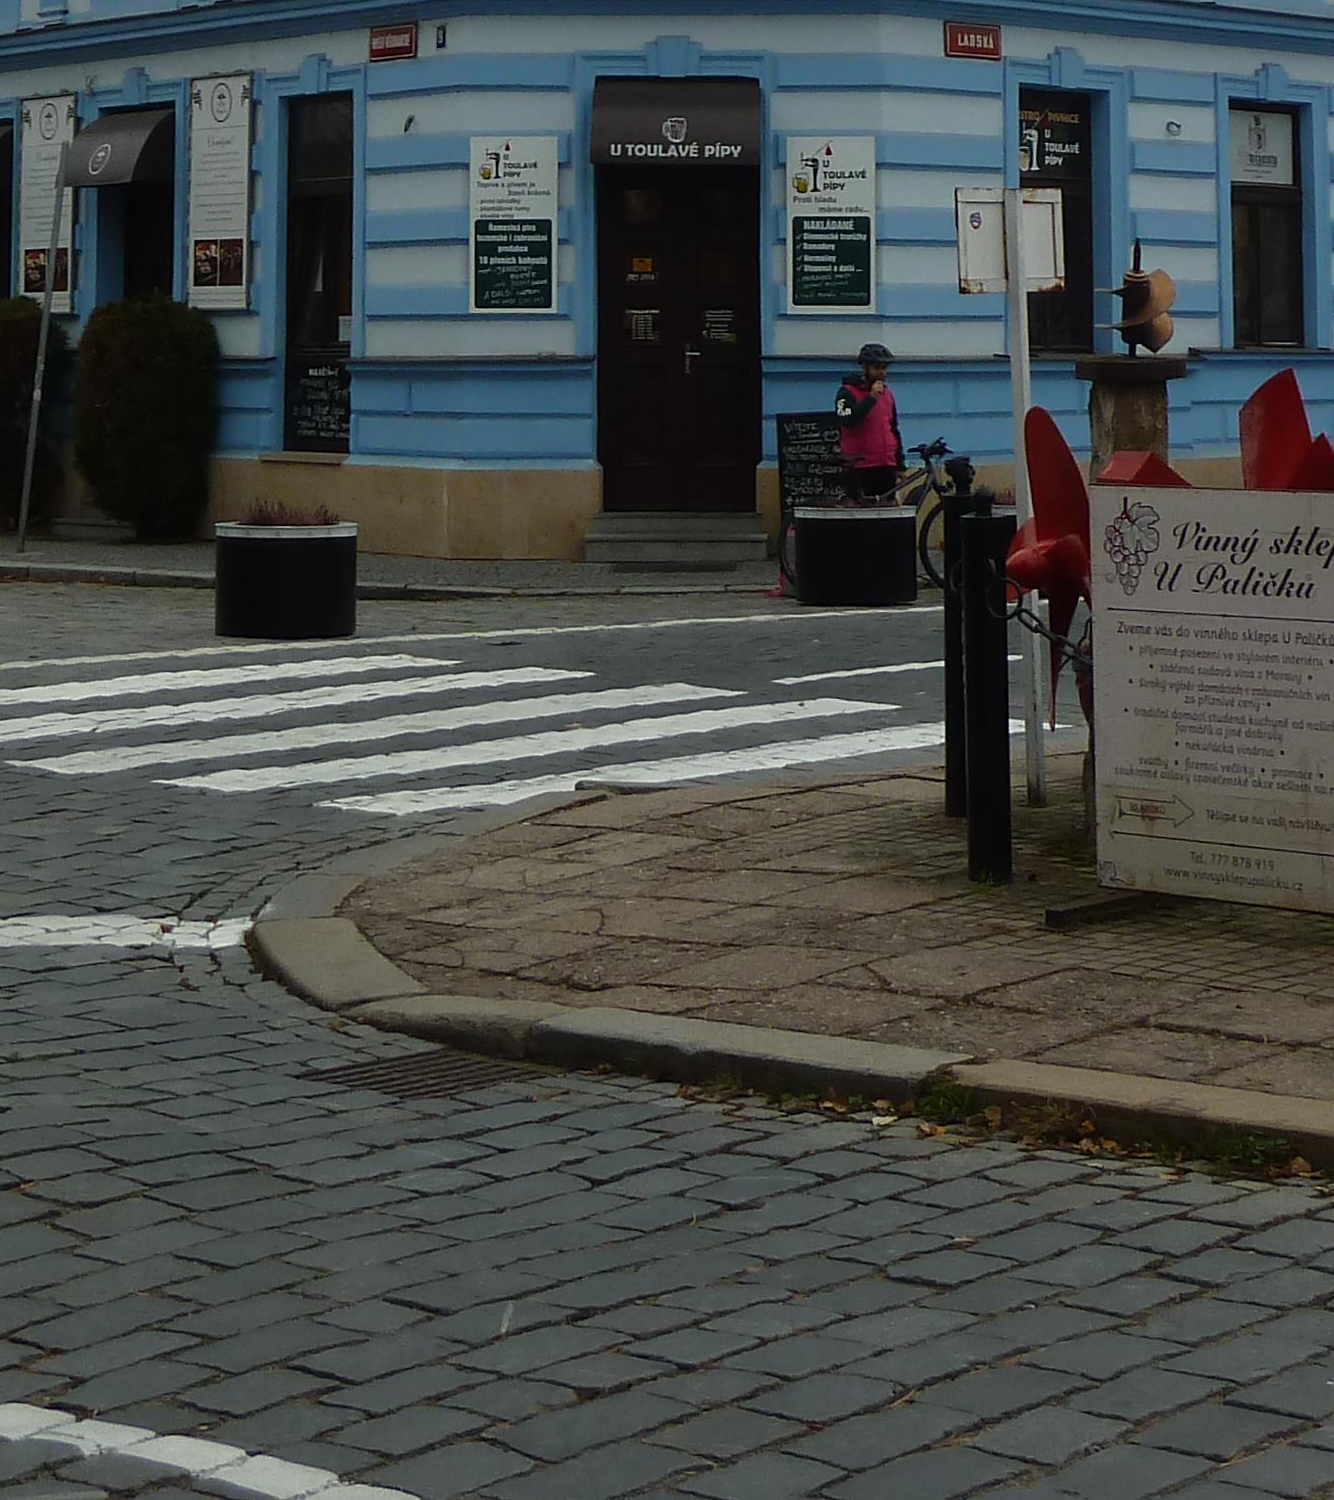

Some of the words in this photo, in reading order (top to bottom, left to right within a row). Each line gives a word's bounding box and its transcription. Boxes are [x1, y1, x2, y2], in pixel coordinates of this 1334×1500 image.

[958, 32, 994, 49] LABSKÁ
[1044, 128, 1051, 139] U
[610, 143, 622, 157] U
[624, 141, 699, 158] TOULAVÉ
[704, 141, 742, 159] PÍPY
[1044, 142, 1080, 154] TOULAVÉ
[822, 160, 830, 168] U
[822, 170, 868, 179] TOULAVÉ
[822, 181, 846, 191] PÍPY
[1172, 521, 1259, 566] Vinný
[1154, 560, 1183, 593] U
[1117, 620, 1152, 636] Zveme
[1154, 622, 1173, 637] vás
[1175, 624, 1190, 639] do
[1194, 626, 1239, 642] vinného
[1242, 629, 1279, 646] sklepa
[1282, 631, 1291, 644] U
